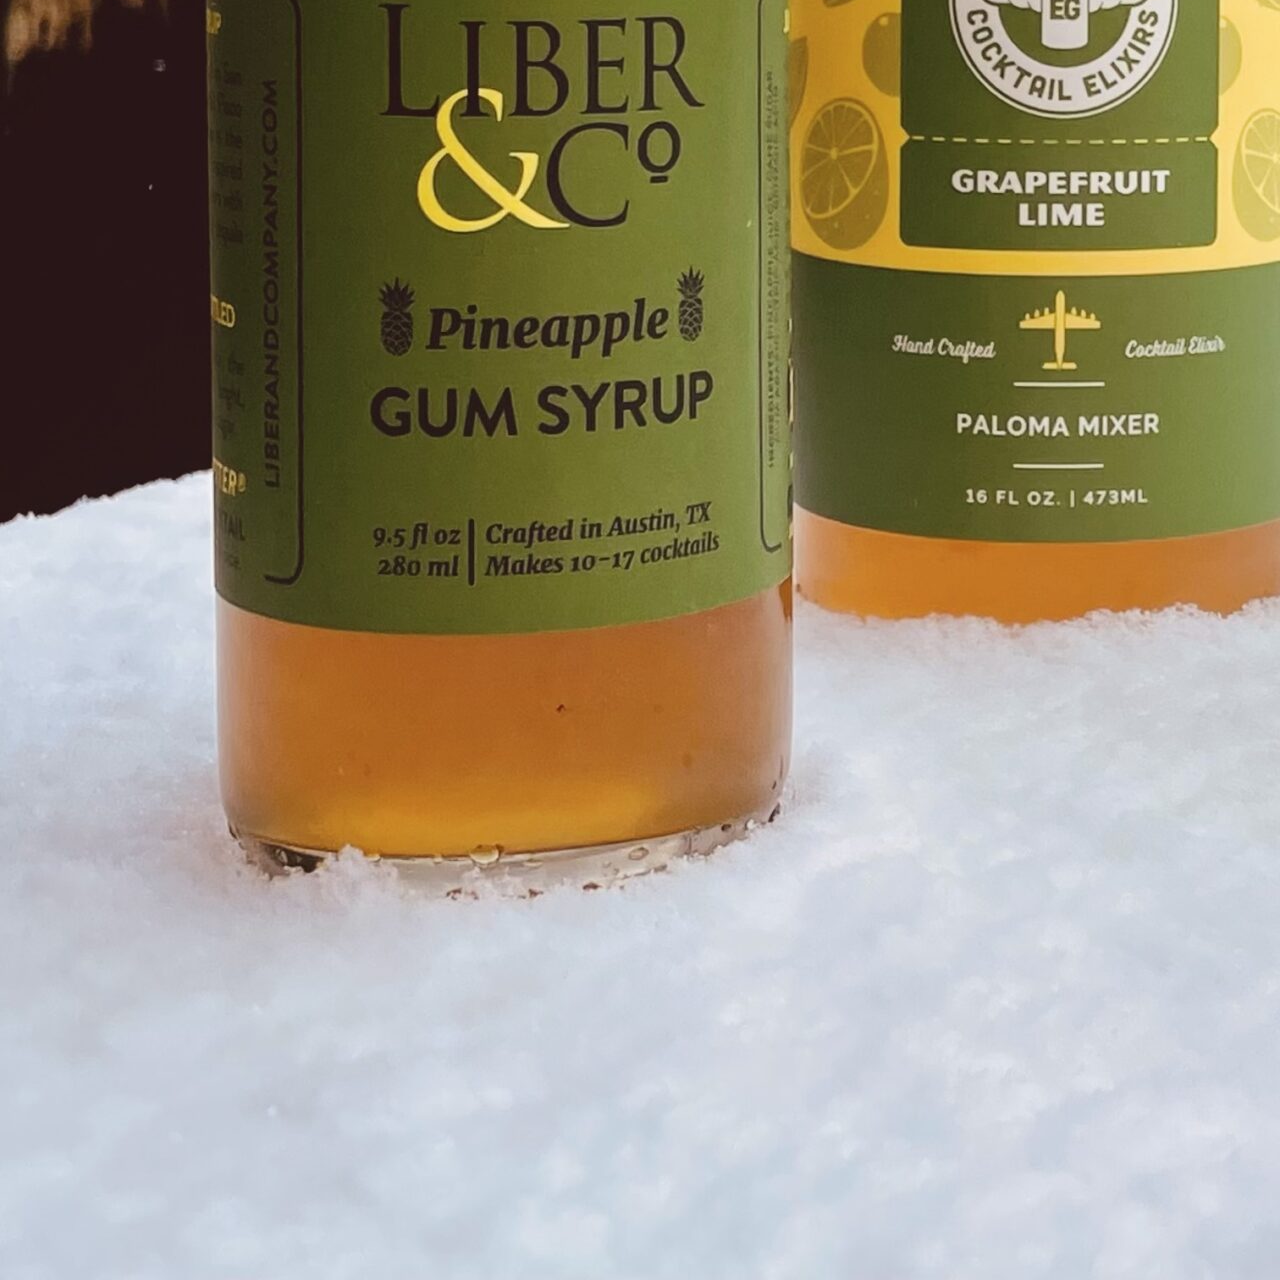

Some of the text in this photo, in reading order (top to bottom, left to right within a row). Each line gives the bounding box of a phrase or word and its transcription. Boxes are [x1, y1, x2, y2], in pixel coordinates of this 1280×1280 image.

[378, 2, 706, 118] LIBER
[966, 8, 1160, 102] COCKTAIL ELIXIRS
[951, 168, 1171, 195] GRAPEFRUIT
[1018, 202, 1106, 227] LIME
[261, 79, 280, 489] LIBERANDCOMPANY.COM
[425, 297, 670, 359] Pineapple
[892, 334, 996, 364] Hand Crafted
[1124, 334, 1226, 359] Cocktail Elixir
[370, 370, 714, 438] GUM SYRUP
[956, 412, 1160, 438] PALOMA MIXER
[965, 487, 1148, 506] 16 FL OZ. 473ML
[372, 522, 462, 551] 9.5 fl oz
[485, 500, 712, 549] Crafted in Austin, TX
[376, 554, 460, 578] 280 ml
[484, 553, 564, 577] Makes
[640, 530, 720, 565] cocktails
